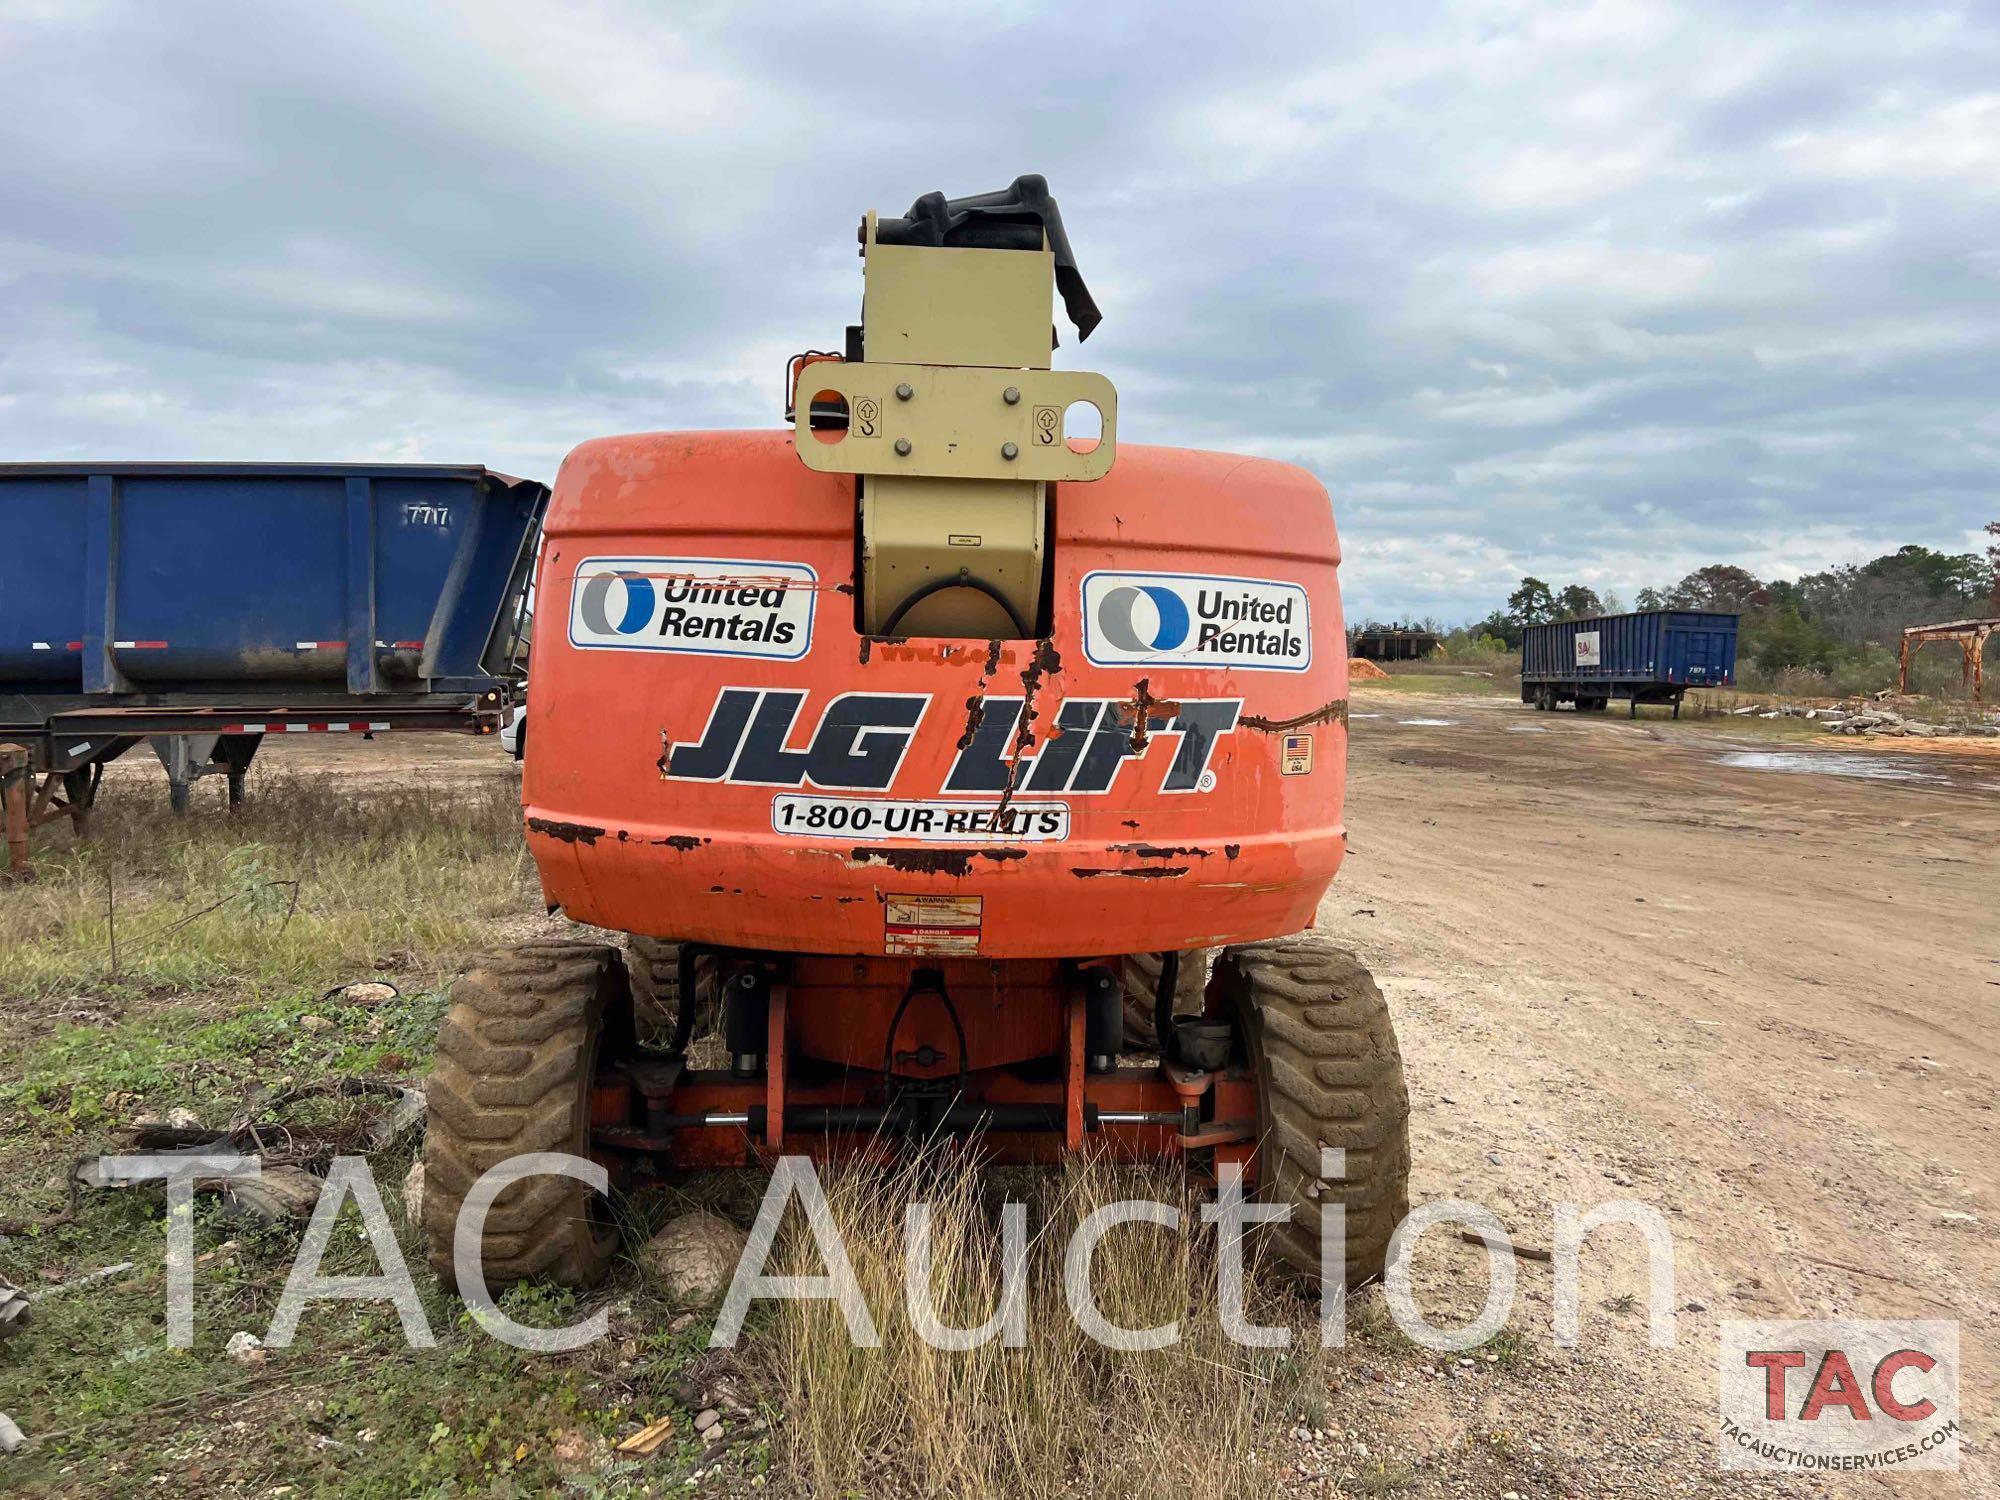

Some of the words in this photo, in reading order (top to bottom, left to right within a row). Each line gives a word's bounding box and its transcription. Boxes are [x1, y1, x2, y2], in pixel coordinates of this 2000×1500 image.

[408, 506, 448, 525] 7717
[664, 574, 791, 608] United
[1197, 590, 1293, 624] United
[659, 607, 796, 644] Rentals
[1197, 623, 1302, 657] Rentals
[664, 686, 933, 793] JLG
[938, 697, 1244, 795] LIFT
